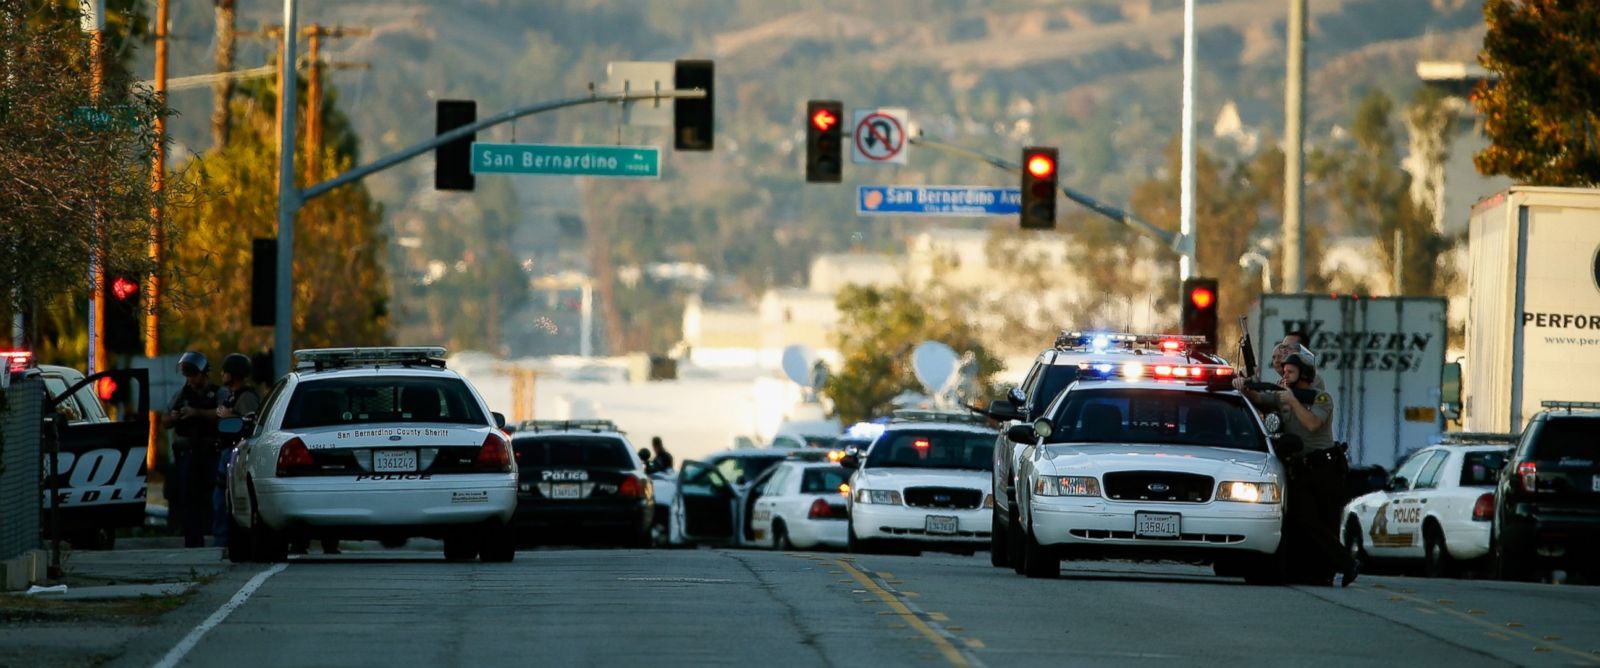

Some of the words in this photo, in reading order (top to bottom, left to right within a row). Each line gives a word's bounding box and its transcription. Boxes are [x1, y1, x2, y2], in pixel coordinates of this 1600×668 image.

[482, 150, 514, 167] San
[522, 151, 618, 170] Bernardino
[886, 189, 913, 203] San
[918, 189, 995, 205] Bernardino
[1522, 311, 1600, 330] PERFOR
[1282, 319, 1433, 352] WESTERN
[337, 431, 351, 439] San
[354, 429, 393, 438] Bernardino
[396, 428, 421, 437] County
[425, 429, 449, 437] Sheriff
[377, 457, 414, 469] 1361242
[42, 487, 147, 504] EDLA
[1393, 507, 1421, 524] POLICE
[1140, 521, 1177, 534] 1358411
